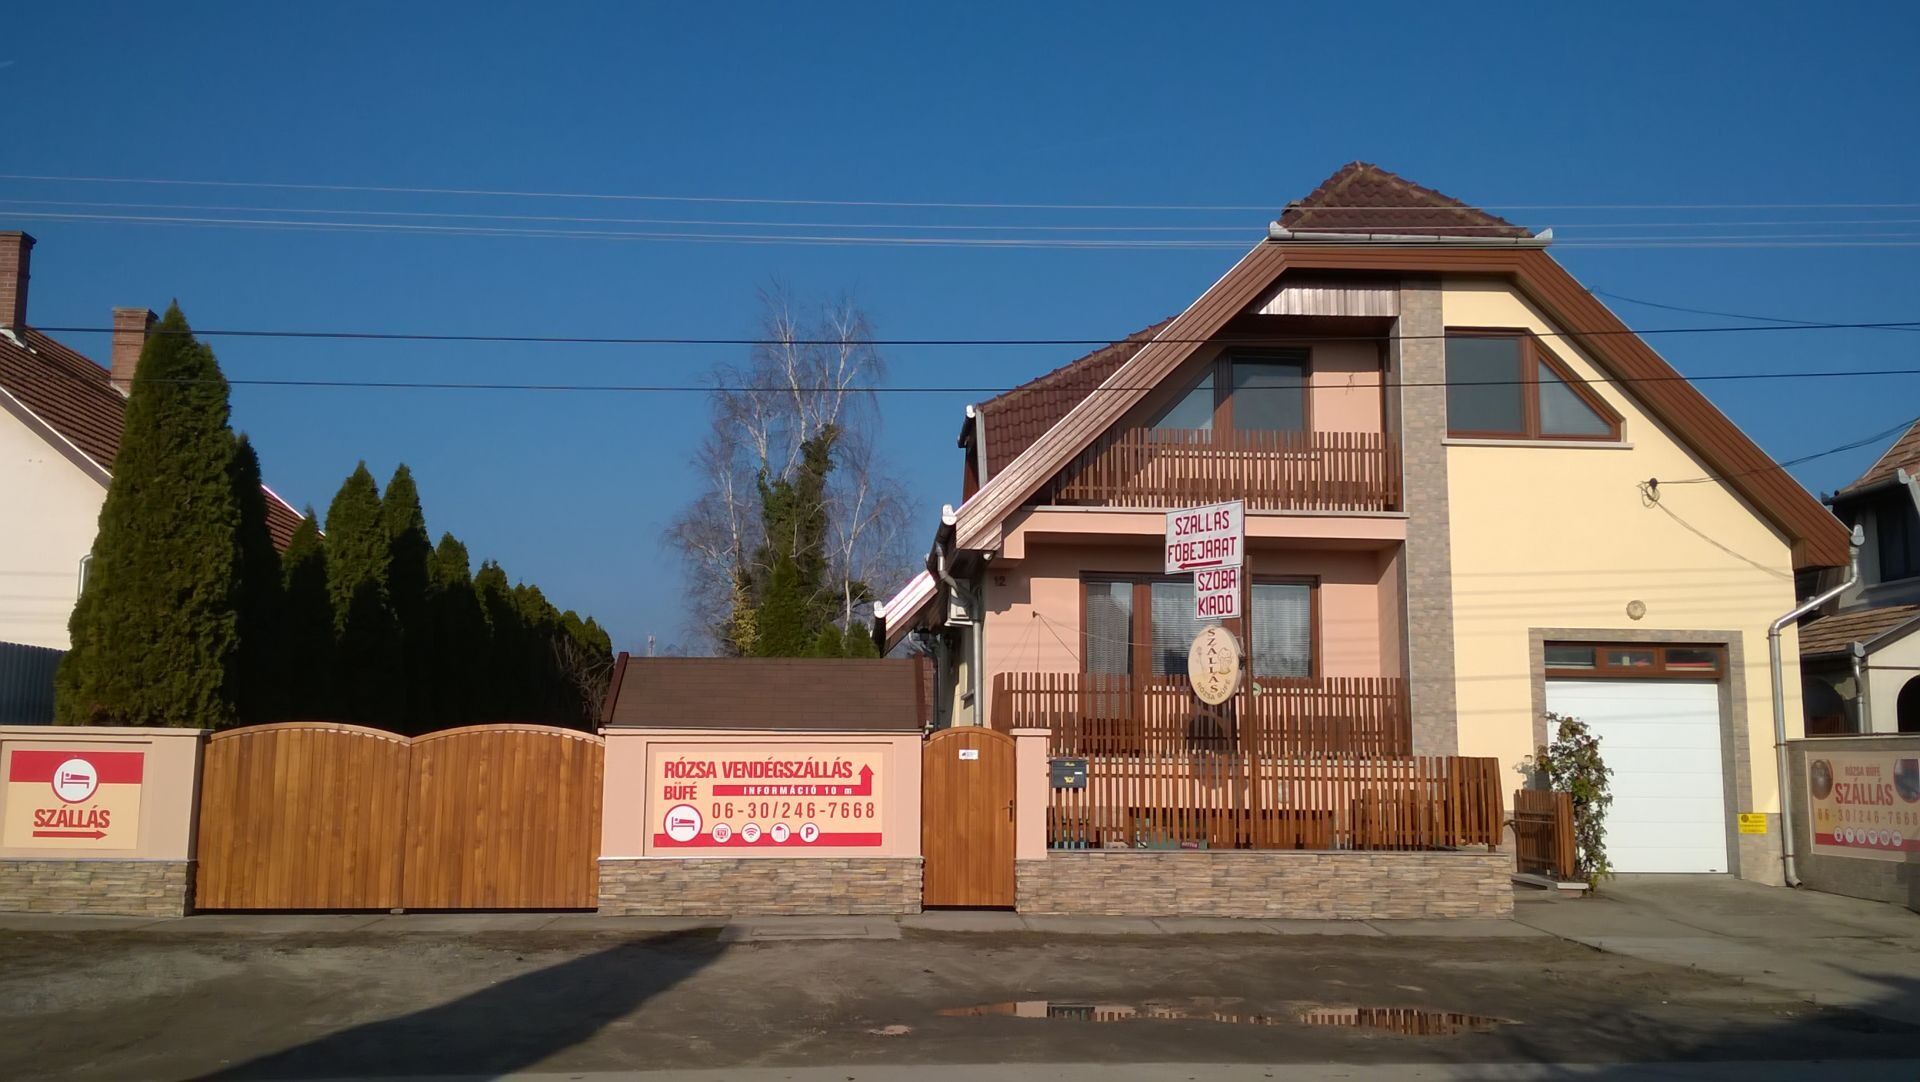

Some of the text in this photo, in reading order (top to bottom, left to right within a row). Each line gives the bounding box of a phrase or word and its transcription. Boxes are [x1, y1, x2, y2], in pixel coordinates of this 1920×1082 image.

[1198, 569, 1236, 591] SZOBA
[1198, 591, 1233, 616] KIADÓ
[664, 756, 853, 778] RÓZSA VENDÉGSZÁLLÁS
[664, 781, 698, 800] BÜFÉ
[743, 784, 852, 795] INFORMÁCIÓ 10 m
[1835, 777, 1894, 806] SZÁLLÁS
[33, 804, 111, 829] SZÁLLÁS
[712, 801, 875, 819] 06-30/246-7668
[805, 826, 815, 839] P
